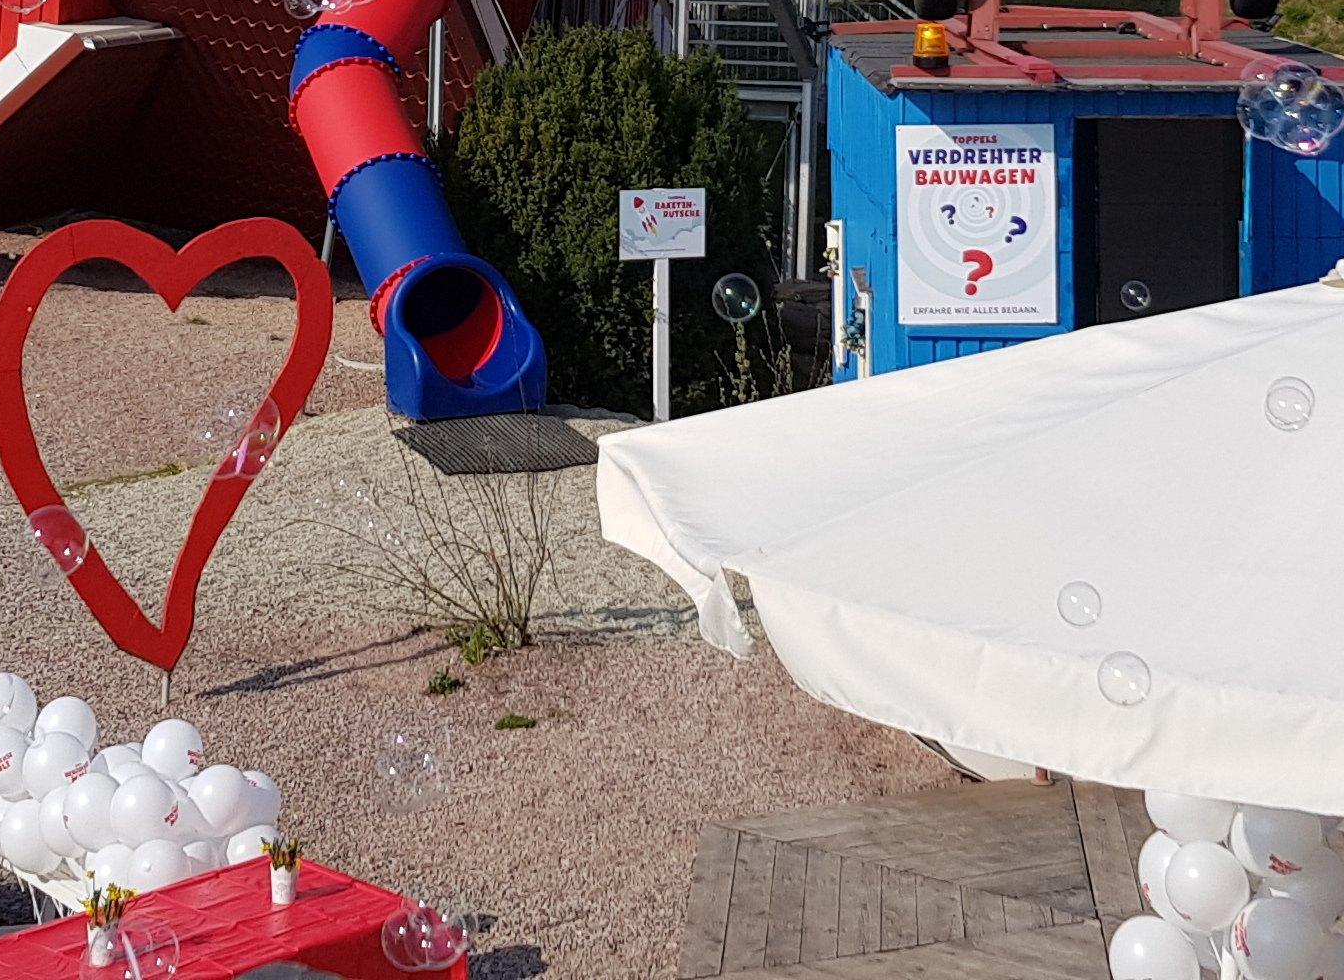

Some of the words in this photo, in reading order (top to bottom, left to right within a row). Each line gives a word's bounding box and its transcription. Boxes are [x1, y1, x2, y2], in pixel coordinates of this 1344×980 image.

[952, 135, 997, 144] TOPPELS
[908, 148, 1042, 165] VERDREHTER
[915, 168, 1035, 185] BAUWAGEN
[663, 209, 701, 218] RUTSCHE
[913, 306, 952, 315] ERFAHRE
[954, 306, 970, 315] WIE
[972, 306, 998, 315] ALLES
